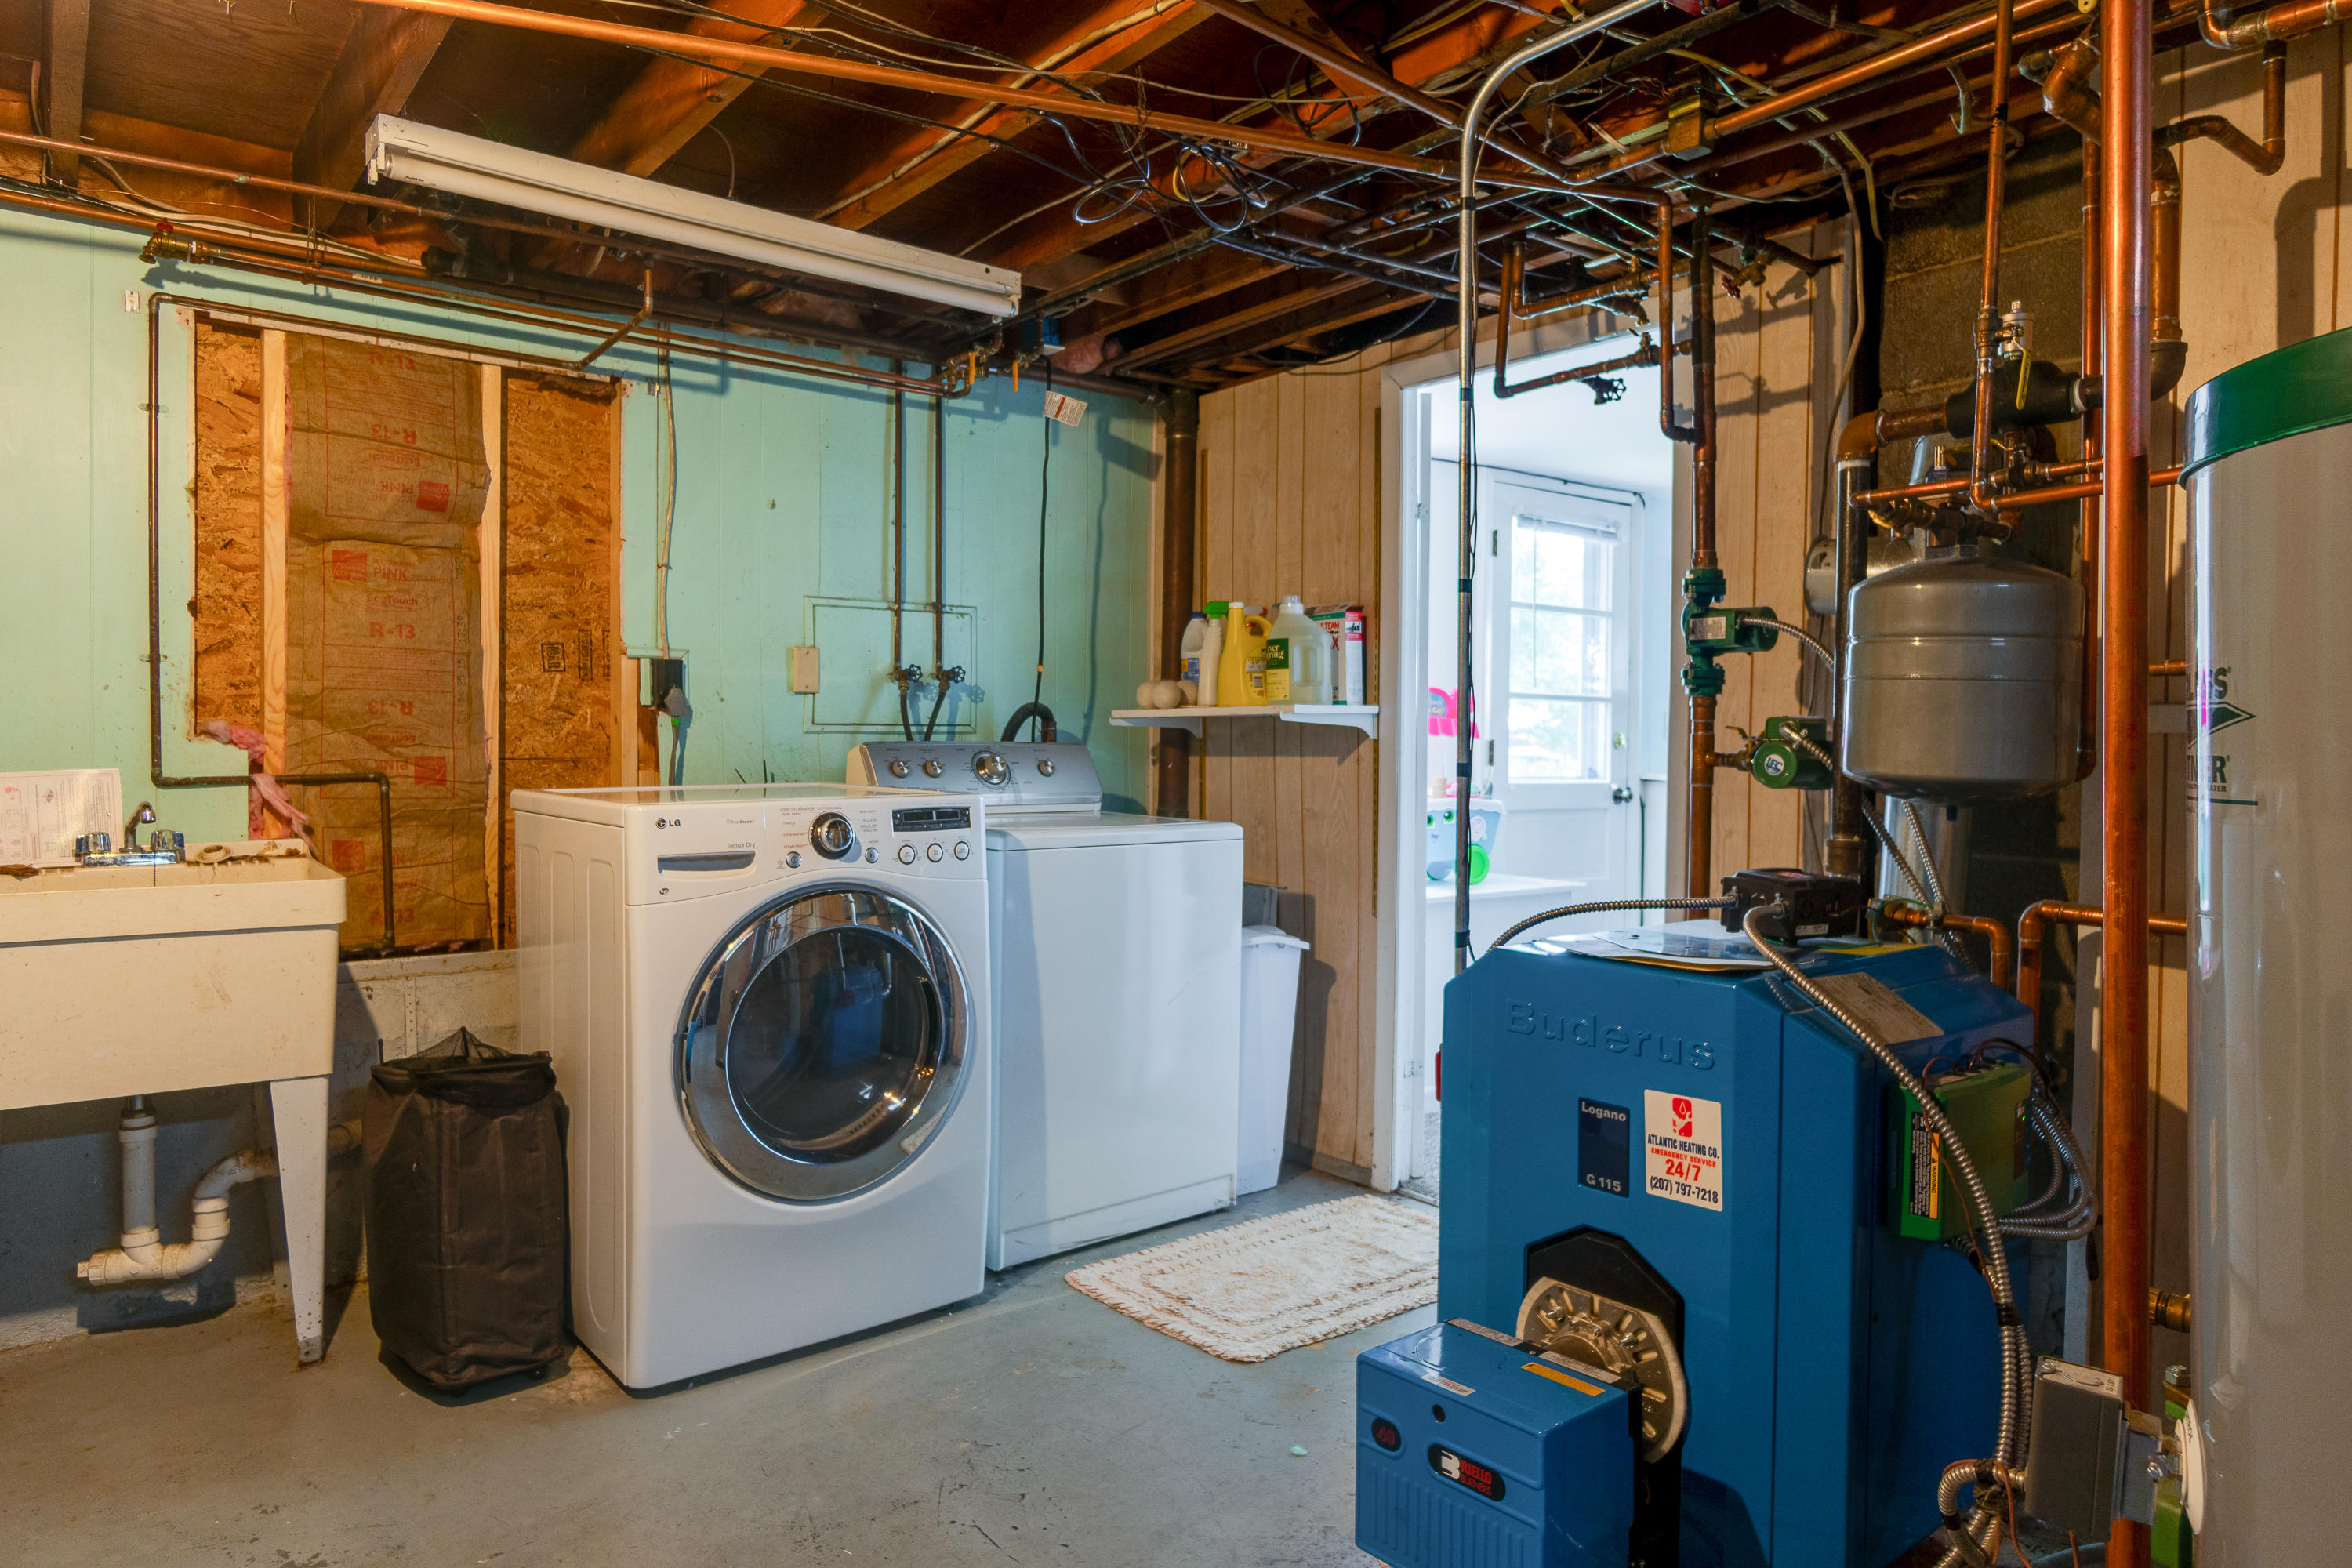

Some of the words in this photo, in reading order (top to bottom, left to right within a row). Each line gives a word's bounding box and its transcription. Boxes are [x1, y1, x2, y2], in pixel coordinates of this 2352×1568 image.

[371, 423, 417, 445] R-13
[378, 481, 413, 495] PINK
[373, 566, 407, 580] PINK
[369, 622, 416, 639] R-13
[368, 700, 413, 716] R-13
[369, 909, 415, 926] R13
[1506, 997, 1715, 1070] Buderus
[1581, 1101, 1626, 1121] Logano
[1647, 1134, 1678, 1150] ATLANTIC
[1679, 1141, 1707, 1156] HEATING
[1708, 1147, 1719, 1160] CO.
[1651, 1147, 1688, 1161] EMERGENCY
[1690, 1155, 1717, 1168] SERVICE
[1665, 1159, 1702, 1182] 24/7
[1586, 1174, 1595, 1185] G
[1599, 1176, 1621, 1192] 115
[1650, 1175, 1673, 1196] (207)
[1675, 1181, 1719, 1203] 797-7218
[1377, 1425, 1396, 1446] 40
[1461, 1459, 1493, 1485] RIELLO
[1461, 1473, 1493, 1496] BURNERS
